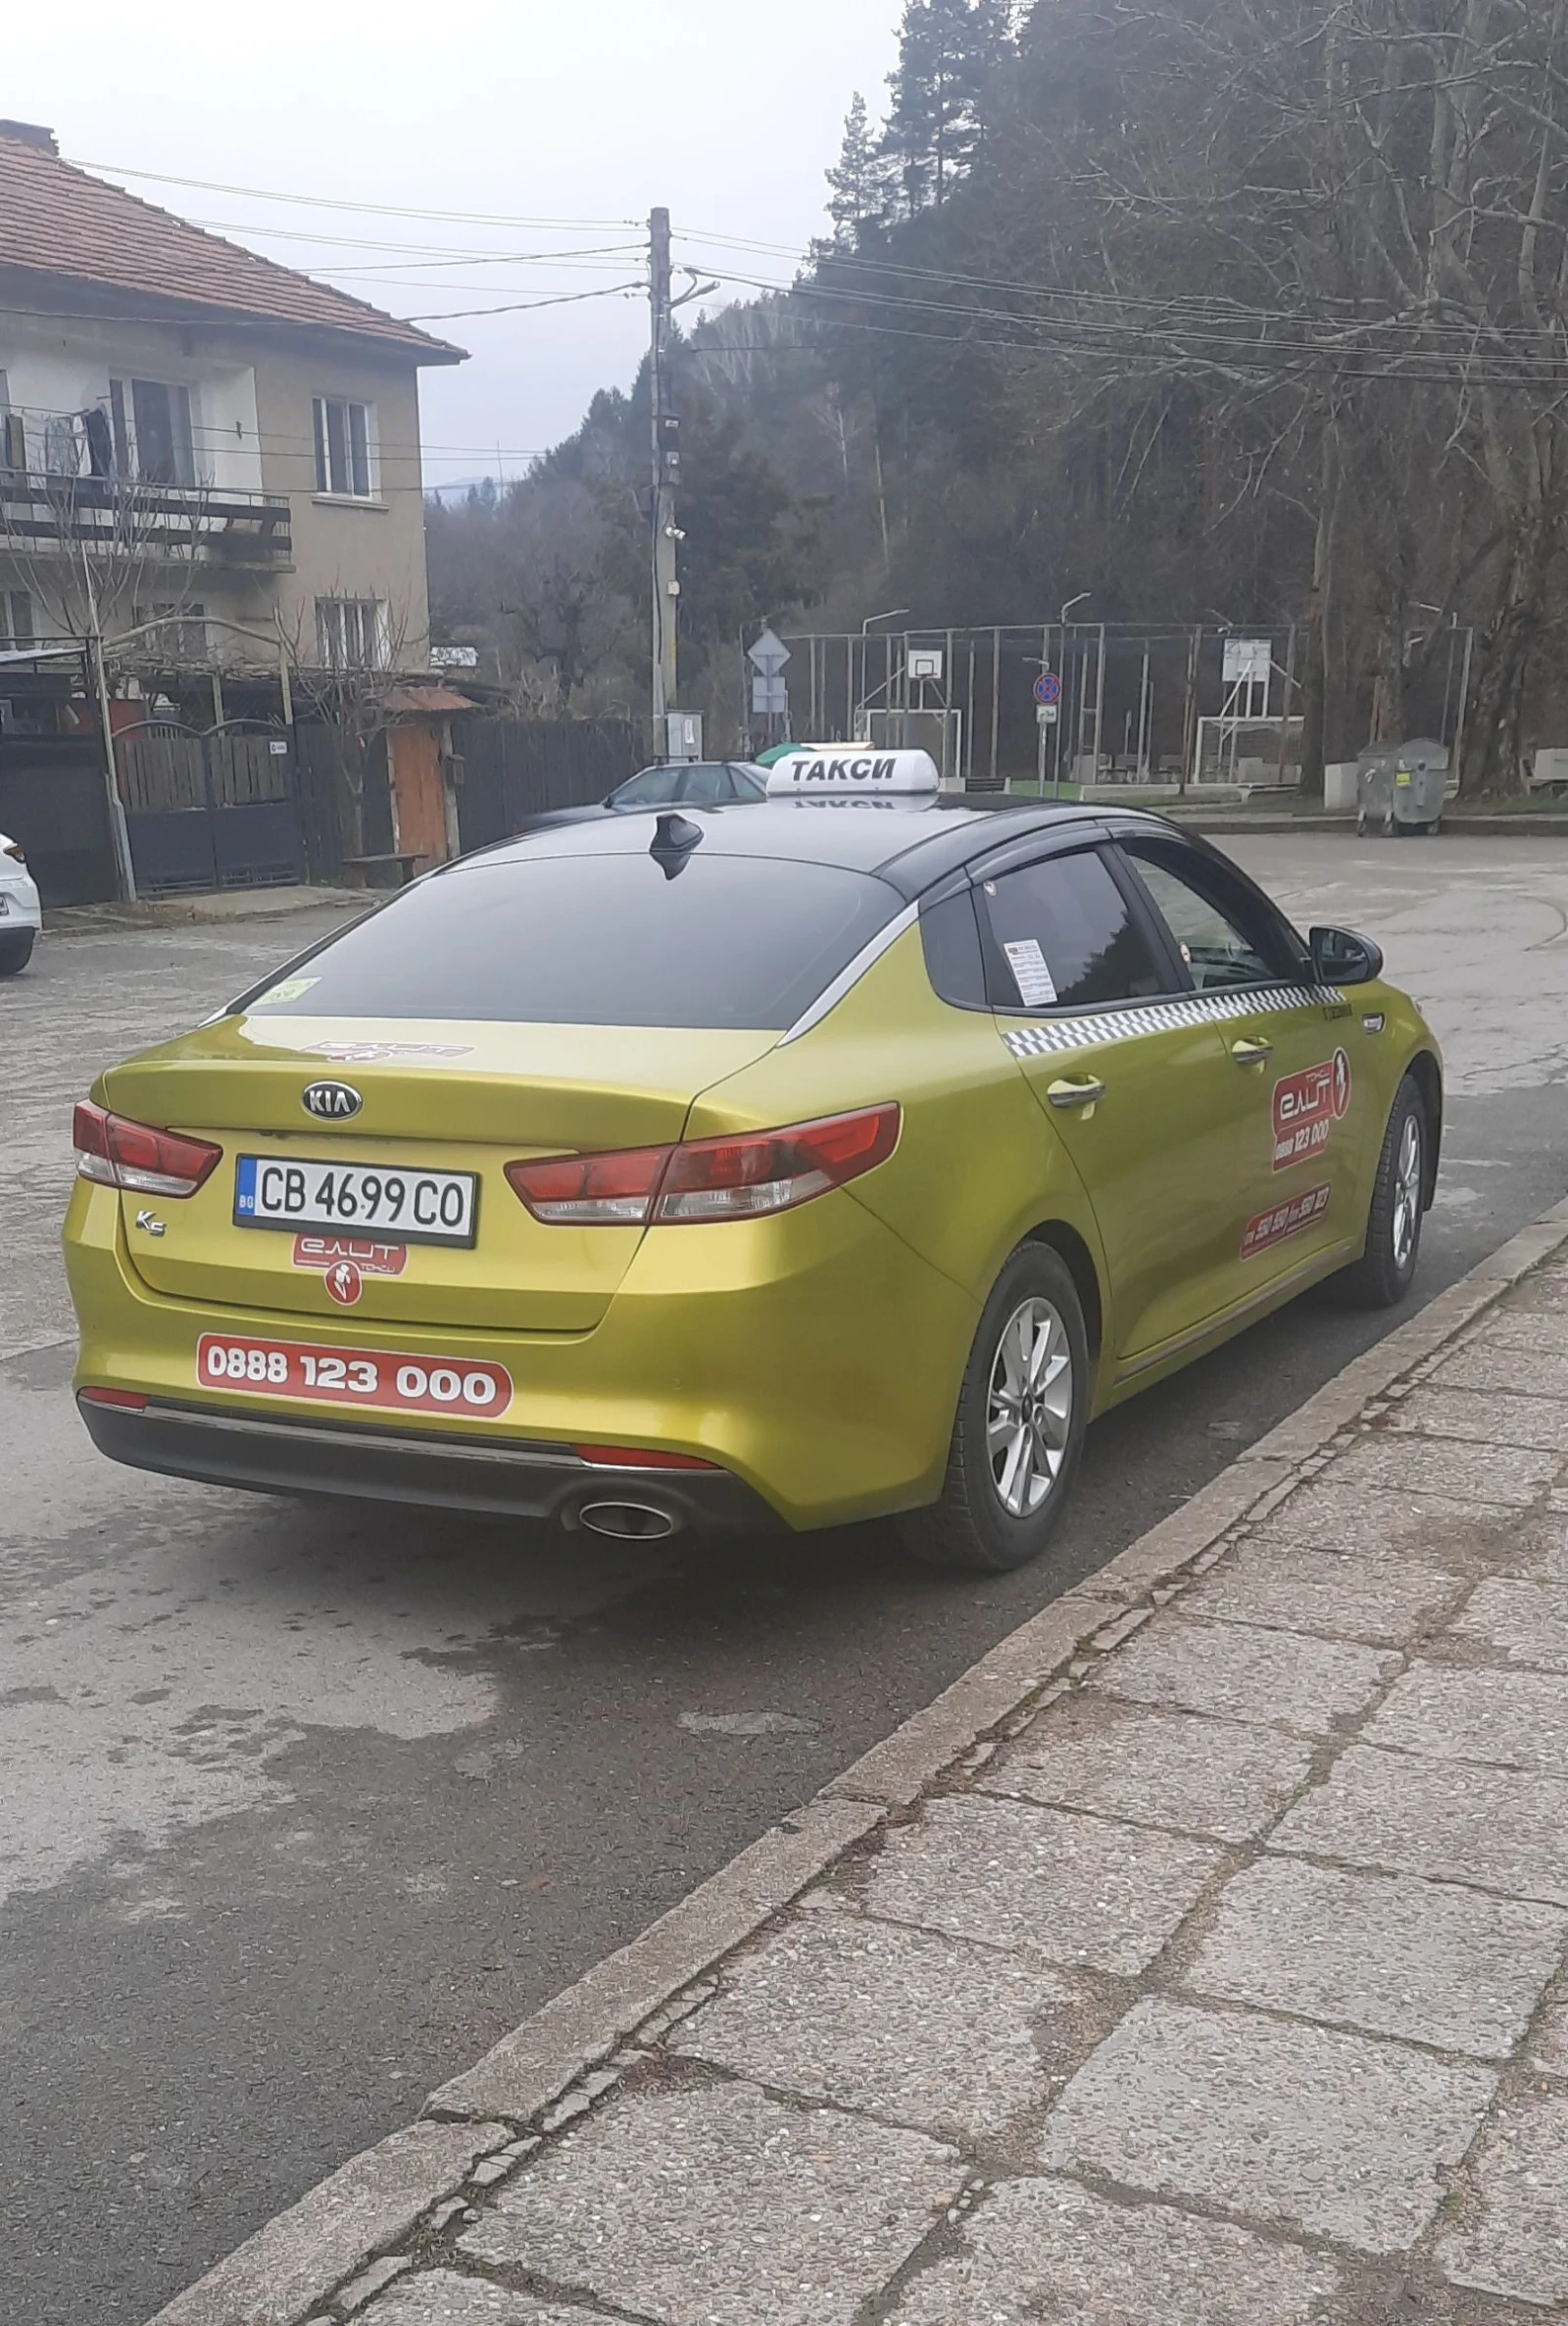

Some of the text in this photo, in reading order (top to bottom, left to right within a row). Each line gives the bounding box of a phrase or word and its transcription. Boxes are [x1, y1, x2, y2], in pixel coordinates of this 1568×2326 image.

[792, 758, 897, 782] ТАКСИ
[309, 1090, 351, 1113] KIA
[1295, 1126, 1311, 1153] 123
[239, 1195, 254, 1209] BG
[262, 1166, 306, 1212] CB
[315, 1171, 406, 1222] 4699
[136, 1211, 167, 1237] K5
[207, 1345, 497, 1405] 0888 123 000
